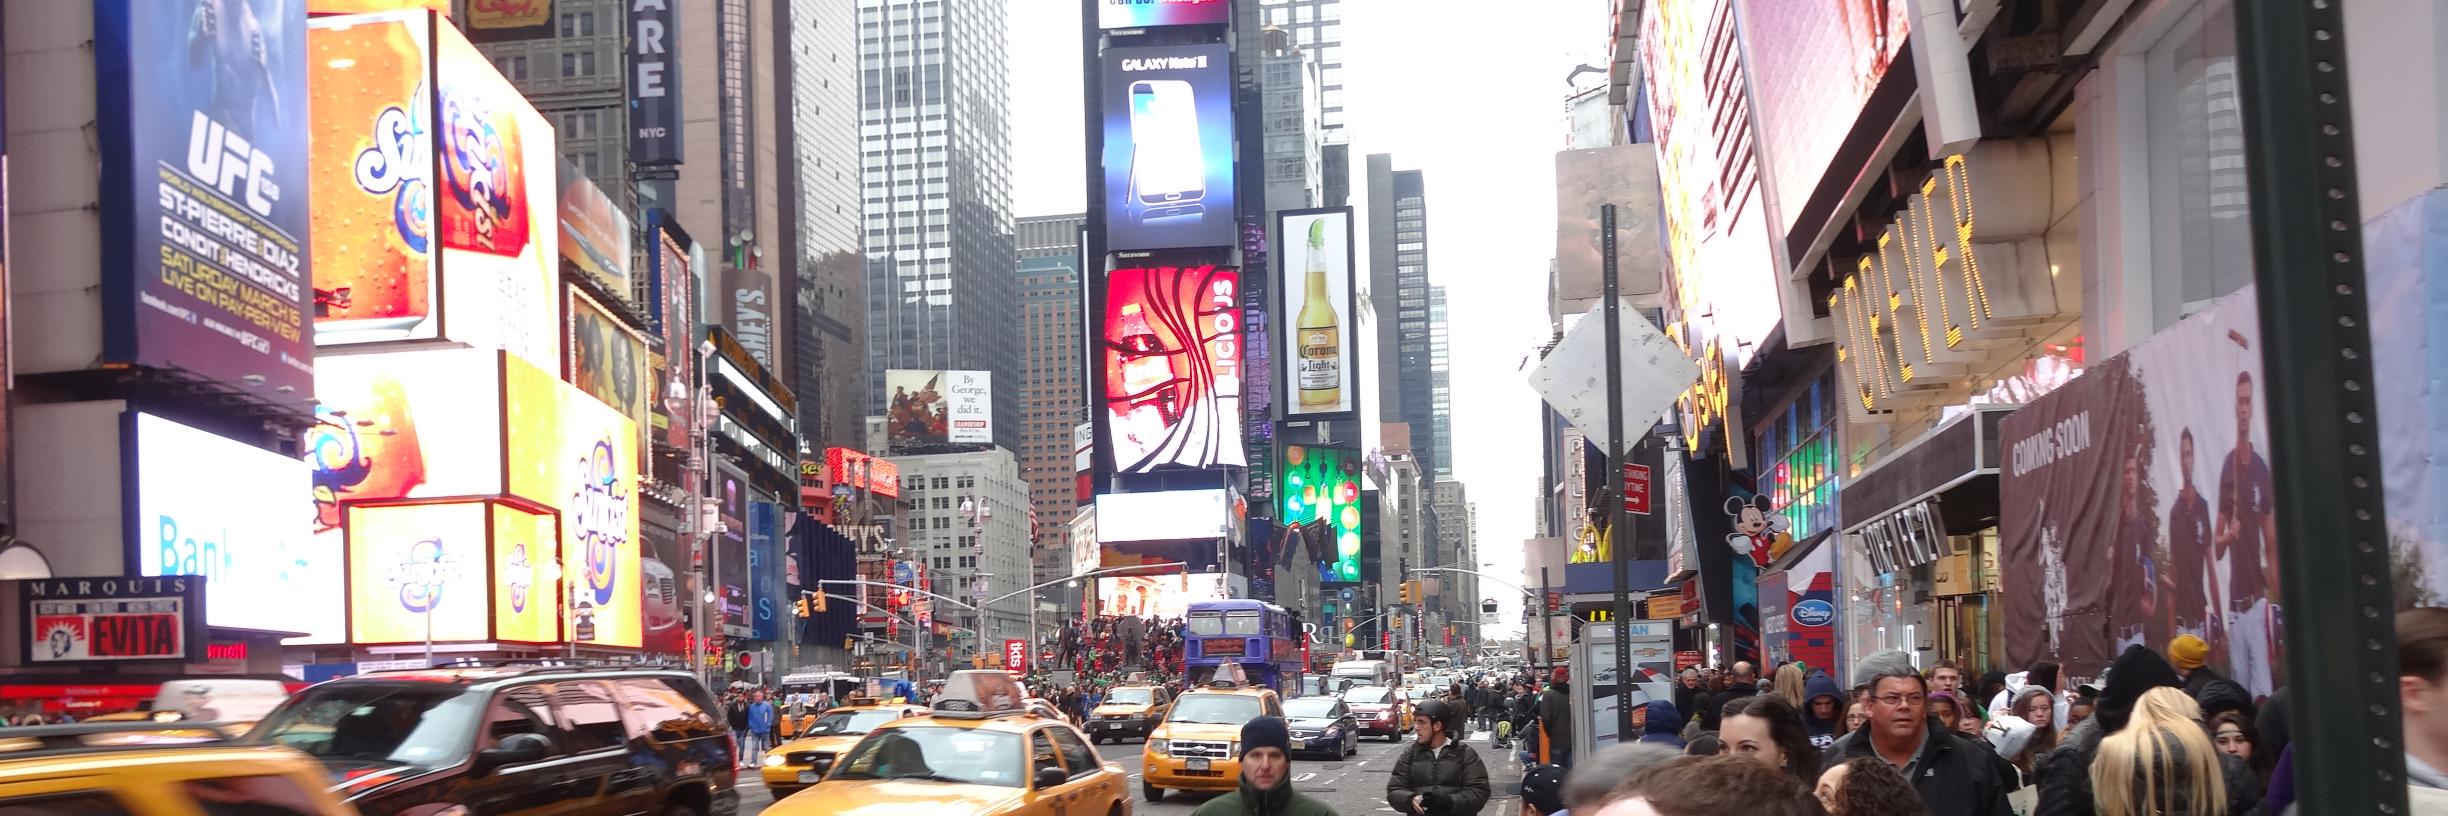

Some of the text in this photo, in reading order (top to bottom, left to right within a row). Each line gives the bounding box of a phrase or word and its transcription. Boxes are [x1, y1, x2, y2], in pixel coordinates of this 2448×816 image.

[1122, 57, 1168, 71] GALAXY
[639, 128, 666, 139] NYC
[188, 109, 275, 217] UFC
[159, 182, 299, 278] ST-PIERRE DIAZ
[161, 214, 299, 302] CONDIT HENDRICKS
[161, 244, 240, 296] SATURDAY
[240, 281, 287, 321] MARCH
[287, 305, 300, 327] 16
[1829, 153, 1992, 422] FOREVER
[161, 266, 194, 296] LIVE
[196, 283, 217, 307] ON
[219, 294, 300, 343] PAY-PER-VIEW
[1300, 345, 1336, 359] Corona
[1308, 360, 1330, 371] Light
[952, 385, 987, 397] George,
[963, 375, 974, 386] By
[957, 404, 982, 414] did it.
[963, 396, 976, 404] we
[2013, 410, 2090, 477] COMING SOON
[827, 525, 884, 553] EY'S
[31, 578, 187, 597] MARQUIS
[1797, 606, 1832, 621] Disney
[93, 615, 174, 656] EVITA
[1010, 642, 1022, 668] tkts
